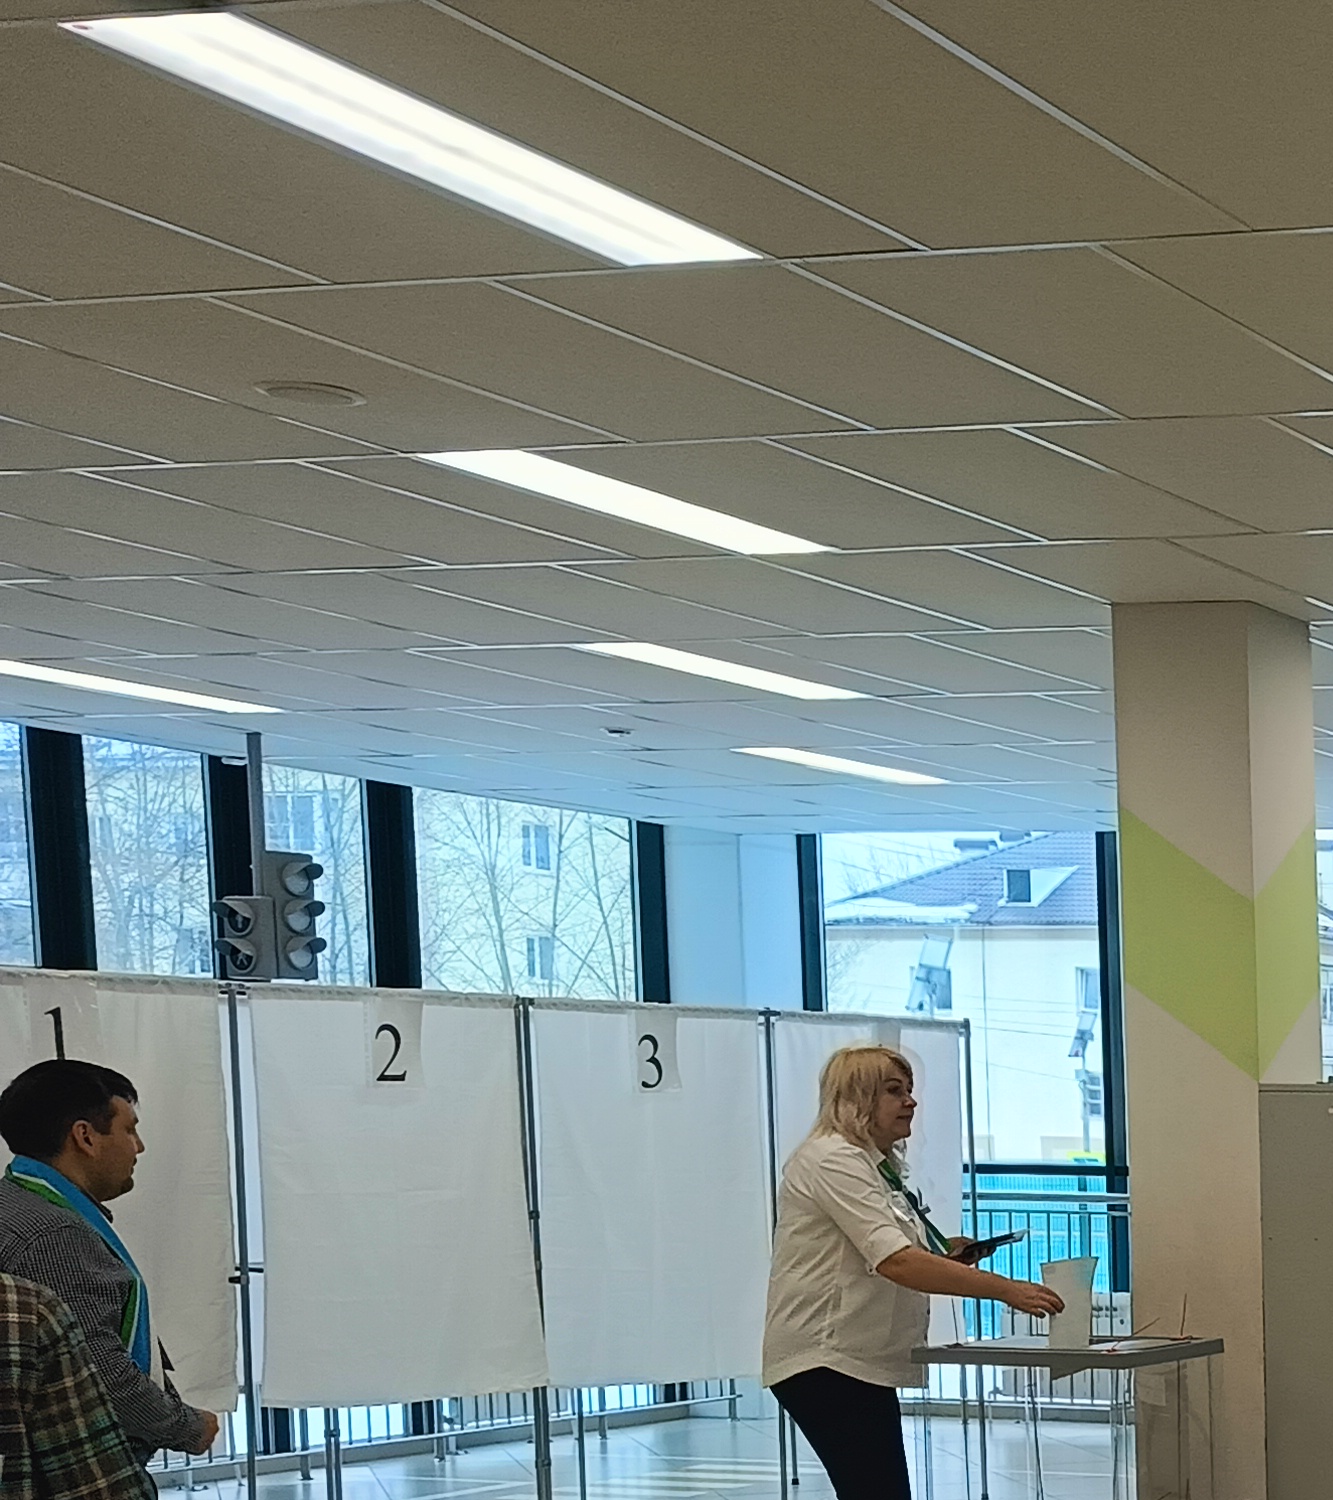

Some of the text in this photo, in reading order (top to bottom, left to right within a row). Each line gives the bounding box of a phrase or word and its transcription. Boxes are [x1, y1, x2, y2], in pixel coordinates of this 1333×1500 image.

[44, 1006, 66, 1060] 1
[374, 1023, 408, 1082] 2
[637, 1033, 664, 1089] 3
